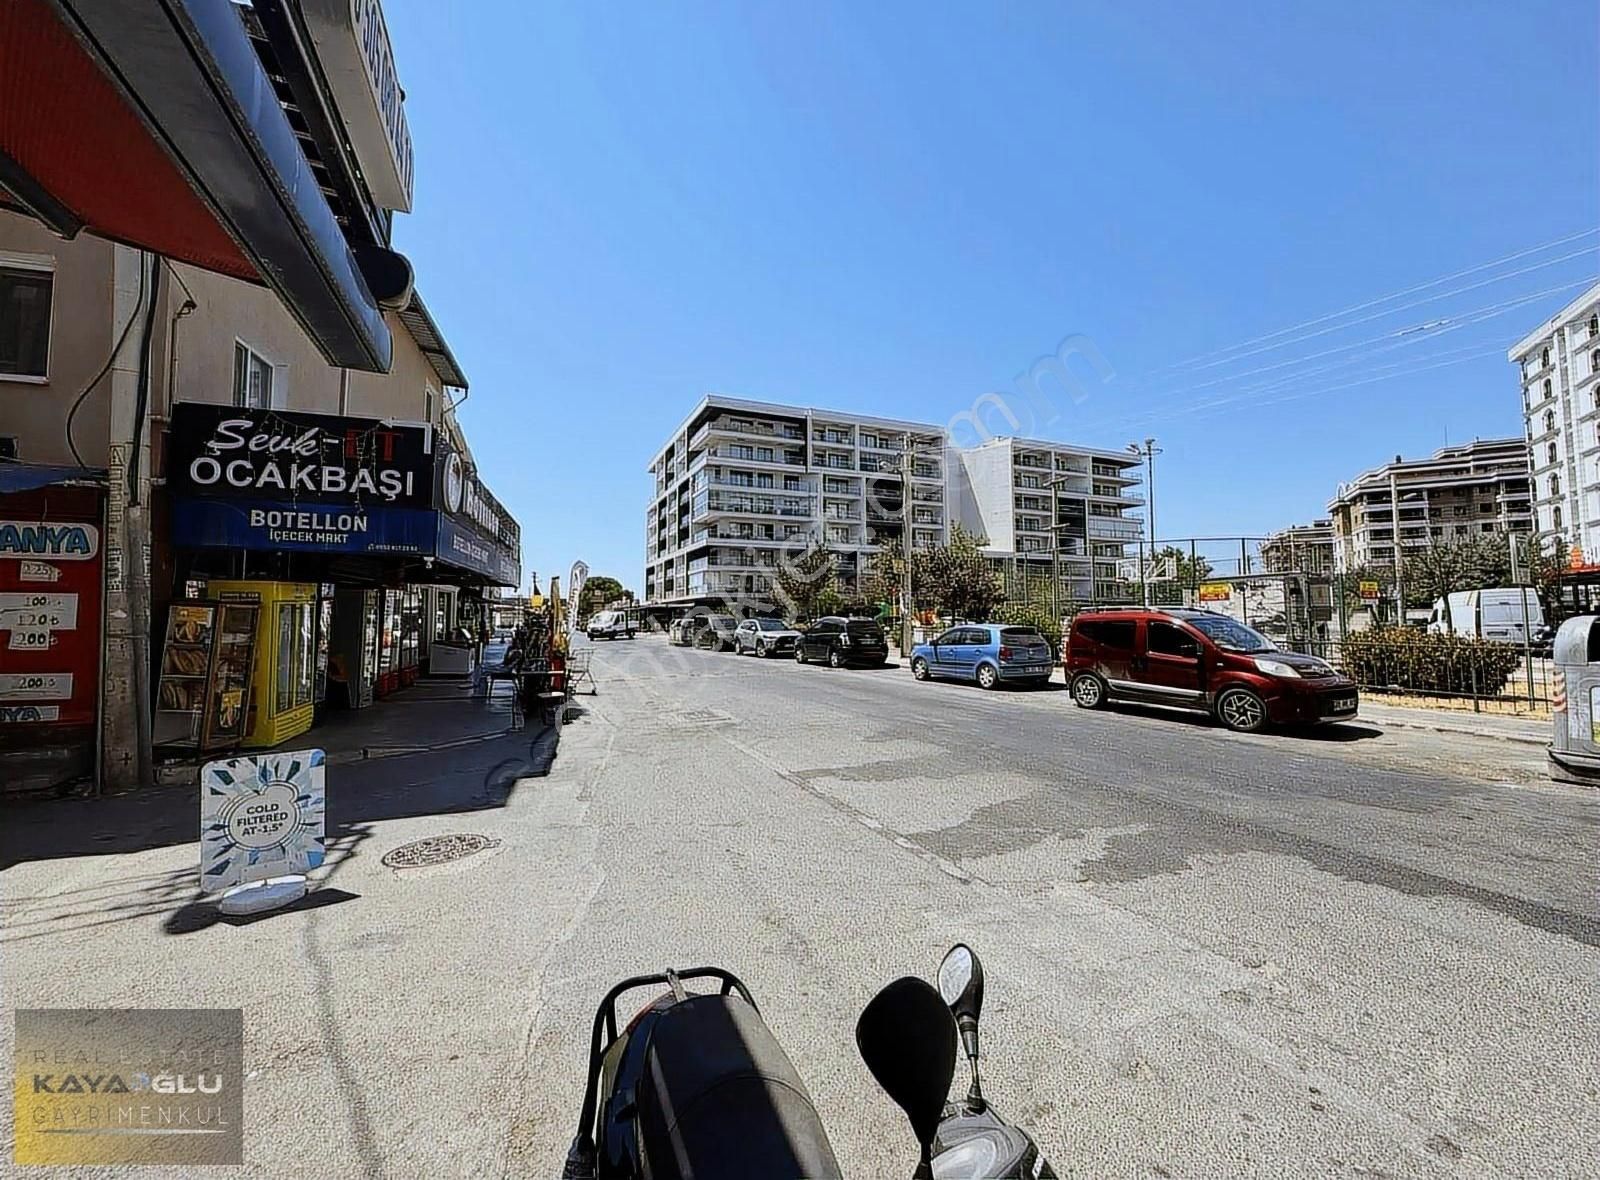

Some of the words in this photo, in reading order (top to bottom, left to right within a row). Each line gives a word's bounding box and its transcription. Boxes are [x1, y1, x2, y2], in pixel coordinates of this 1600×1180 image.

[190, 457, 413, 501] OCAKBAŞI
[250, 509, 368, 532] BOTELLON
[269, 528, 313, 543] İÇECEK
[246, 803, 279, 815] COLD
[237, 812, 288, 827] FILTERED
